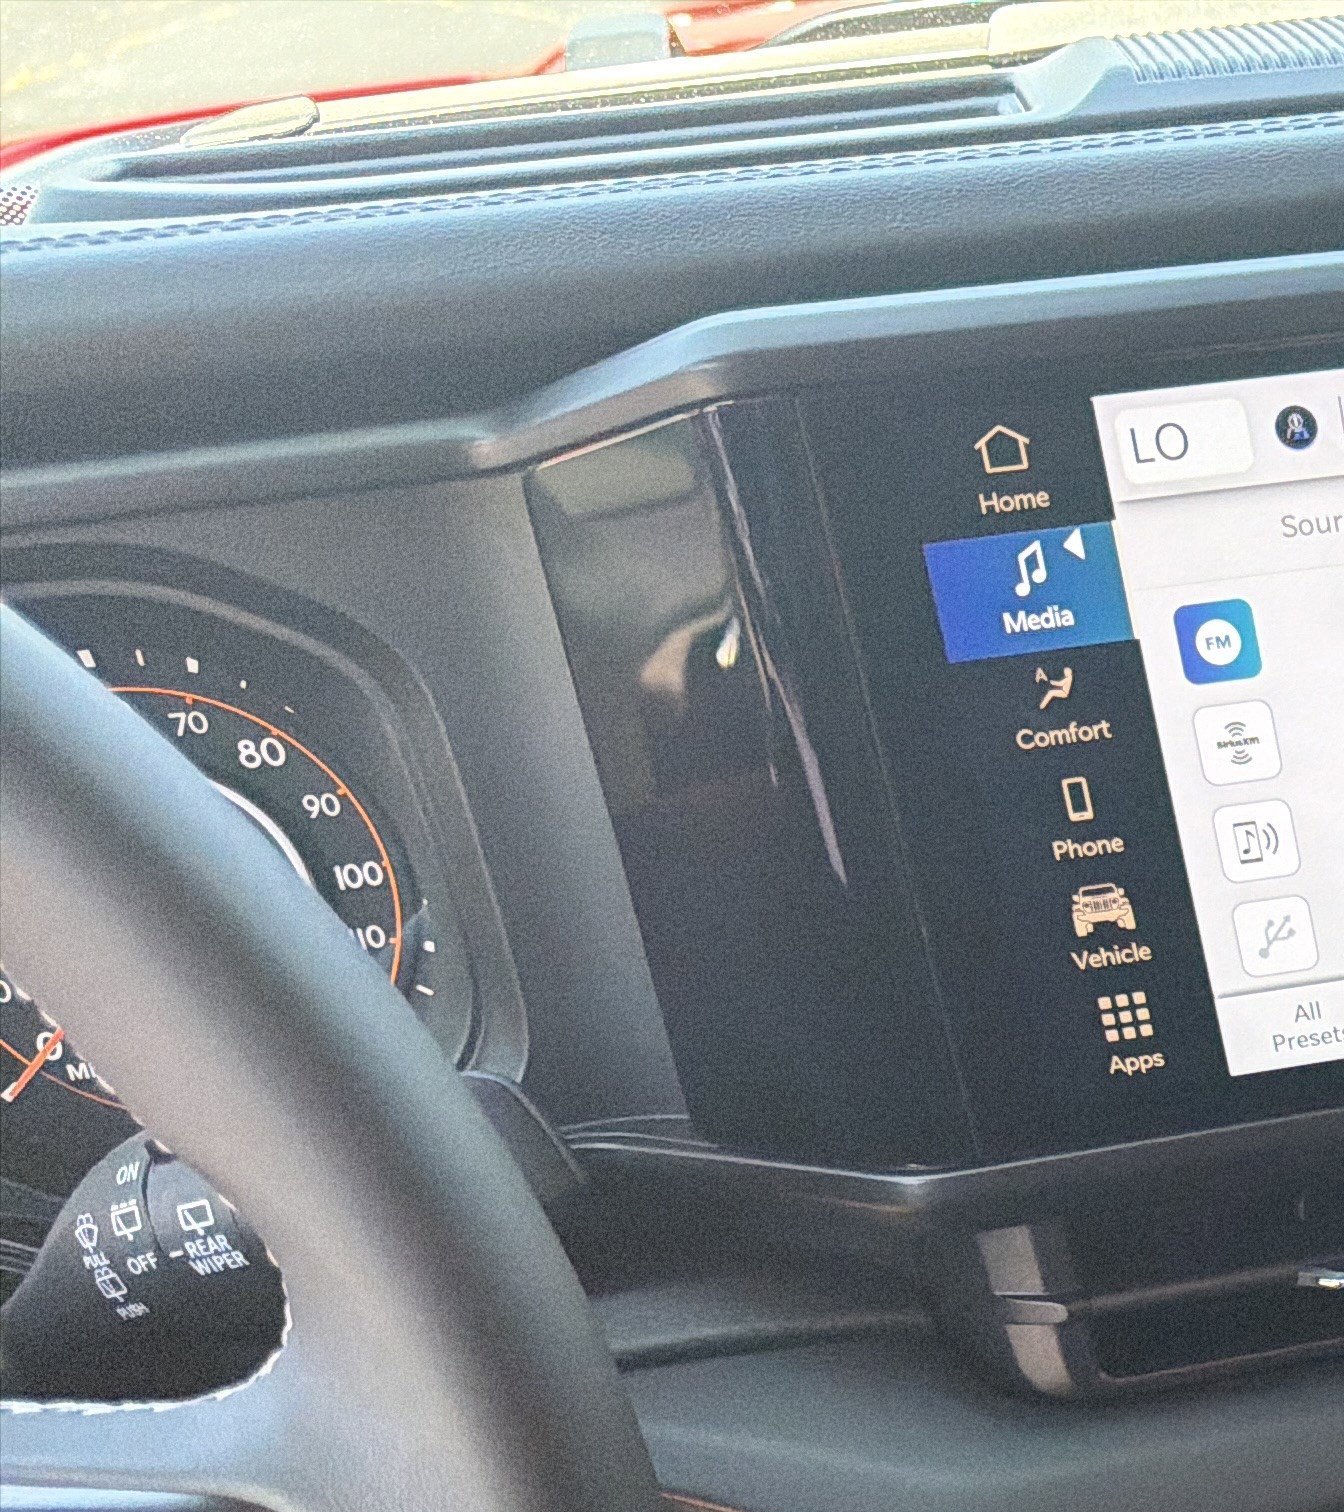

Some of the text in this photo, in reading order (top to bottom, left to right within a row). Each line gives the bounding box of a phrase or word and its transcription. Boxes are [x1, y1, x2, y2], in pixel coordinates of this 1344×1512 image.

[1130, 422, 1189, 464] LO
[978, 490, 1051, 515] Home
[1002, 605, 1075, 634] Media
[1204, 634, 1232, 652] FM
[167, 710, 209, 737] 70
[1016, 720, 1112, 749] Comfort
[237, 737, 286, 769] 80
[301, 792, 341, 819] 90
[1052, 837, 1125, 861] Phone
[333, 861, 384, 891] 100
[1070, 942, 1152, 970] Vehicle
[1294, 1001, 1322, 1023] All
[1109, 1052, 1166, 1076] Apps
[116, 1161, 141, 1185] ON
[184, 1234, 232, 1259] REAR
[82, 1251, 110, 1270] PULL
[126, 1252, 158, 1275] OFF
[188, 1251, 251, 1277] WIPER
[116, 1302, 150, 1321] PUSH
